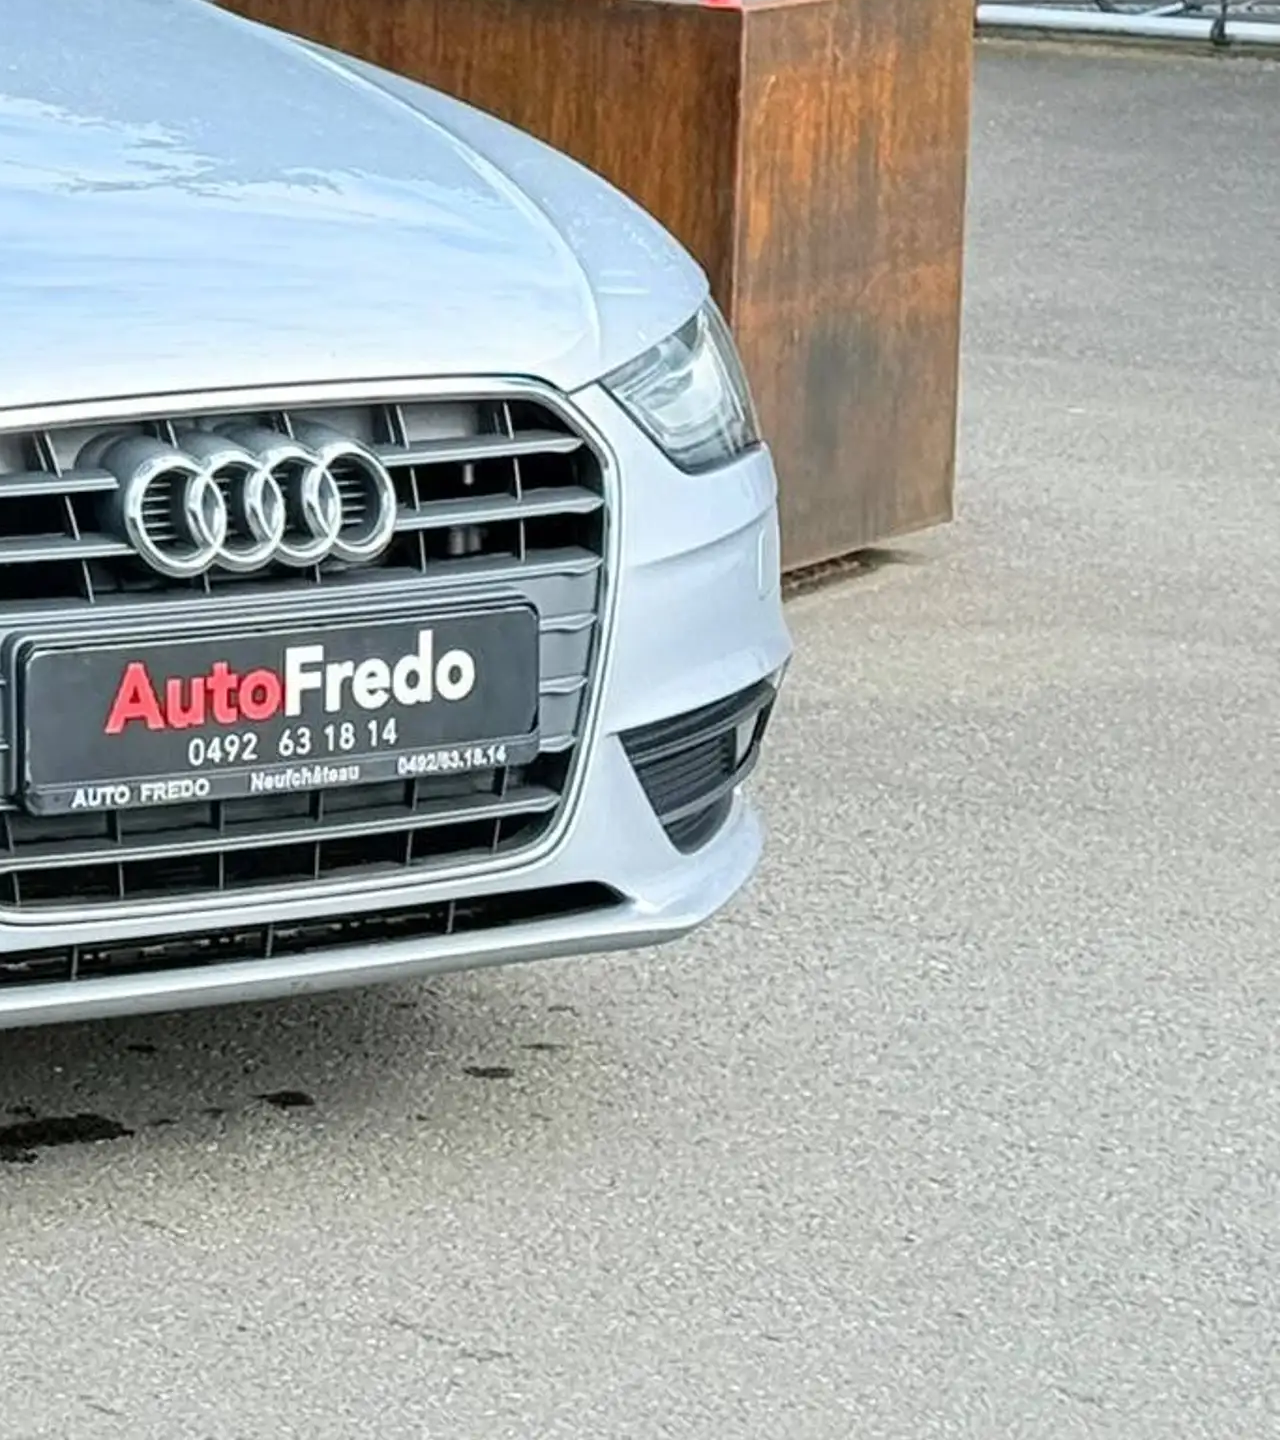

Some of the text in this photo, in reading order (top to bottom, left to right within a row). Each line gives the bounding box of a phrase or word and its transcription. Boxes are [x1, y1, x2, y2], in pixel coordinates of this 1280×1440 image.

[104, 628, 476, 735] AutoFredo
[187, 717, 399, 767] 0492 63 18 14
[71, 785, 131, 810] AUTO
[140, 777, 211, 803] FREDO
